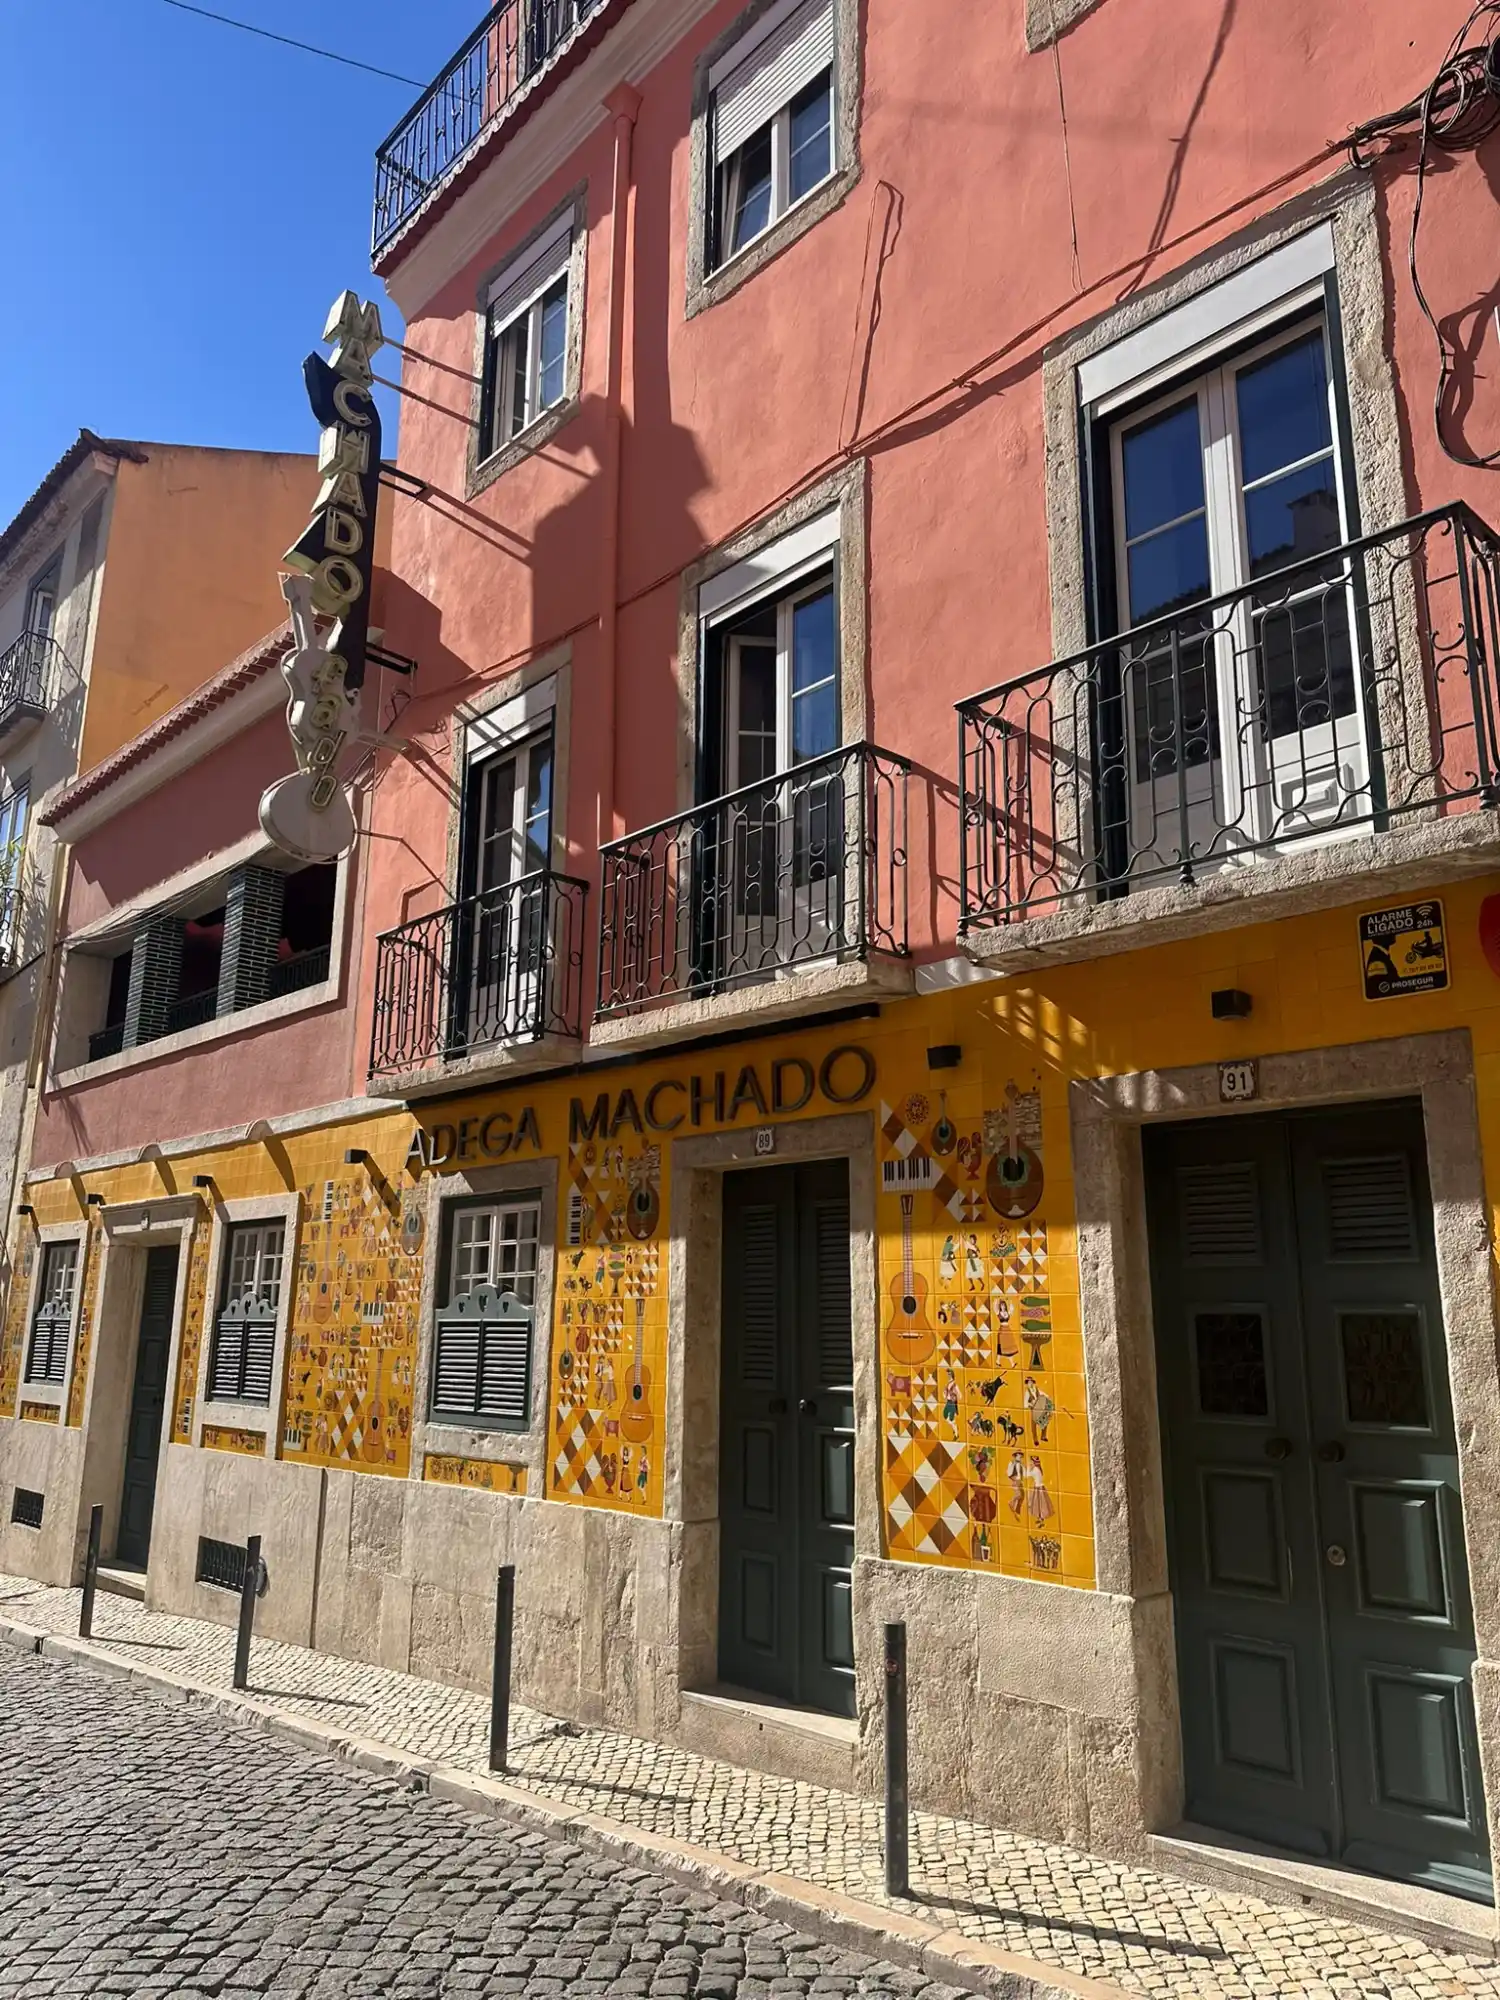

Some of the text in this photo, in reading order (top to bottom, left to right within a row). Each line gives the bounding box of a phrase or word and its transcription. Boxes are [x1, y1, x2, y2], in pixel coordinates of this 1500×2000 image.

[317, 288, 384, 604] MACHADO
[1367, 908, 1413, 925] ALARME
[1416, 918, 1434, 929] 24h
[1367, 917, 1414, 935] LIGADO
[1391, 976, 1434, 989] PROSEGUR
[1227, 1071, 1246, 1091] 91
[403, 1045, 876, 1167] ADEGA MACHADO
[759, 1133, 770, 1149] 89
